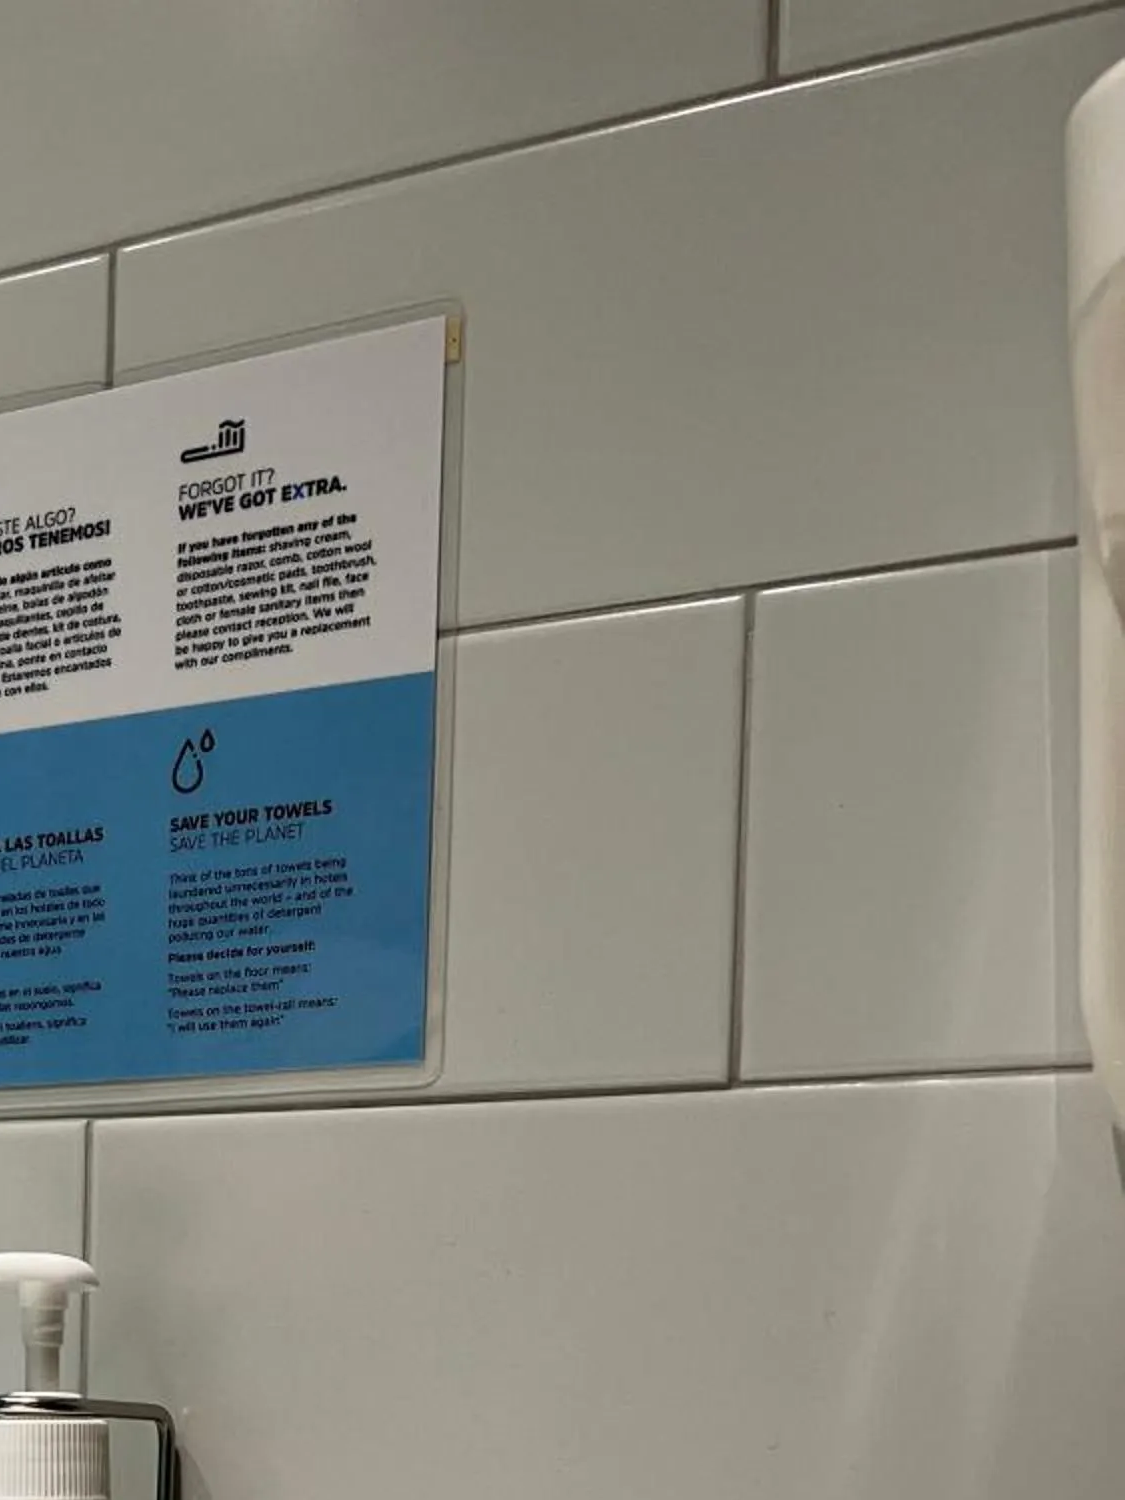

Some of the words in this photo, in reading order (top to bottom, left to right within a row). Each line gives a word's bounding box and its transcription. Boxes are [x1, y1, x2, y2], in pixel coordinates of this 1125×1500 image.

[179, 474, 246, 501] FORGOT
[251, 468, 275, 487] IT?
[179, 496, 235, 521] WE'VE
[239, 487, 277, 509] GOT
[281, 476, 347, 502] EXTRA.
[25, 507, 75, 531] ALGO?
[29, 519, 110, 549] TENEMOS!
[178, 542, 187, 554] If
[189, 541, 209, 553] you
[212, 535, 239, 548] have
[241, 525, 294, 542] forgotten
[297, 521, 319, 532] any
[321, 516, 334, 528] of
[337, 514, 357, 525] the
[177, 552, 229, 568] following
[269, 537, 311, 552] shaving
[306, 547, 341, 560] cotton
[345, 540, 372, 553] wool
[177, 588, 188, 597] or
[239, 587, 277, 602] sewing
[299, 578, 319, 591] nail
[345, 572, 369, 584] face
[175, 628, 209, 642] please
[212, 620, 252, 635] contact
[313, 608, 331, 619] We
[335, 603, 354, 616] will
[176, 614, 202, 627] cloth
[205, 612, 216, 622] or
[219, 605, 256, 619] female
[259, 598, 301, 613] sanitary
[305, 592, 335, 605] items
[339, 588, 365, 600] then
[175, 646, 189, 656] be
[192, 640, 225, 652] happy
[228, 638, 239, 647] to
[242, 634, 264, 646] give
[267, 630, 287, 642] you
[291, 628, 297, 638] a
[300, 616, 370, 636] replacement
[175, 658, 197, 670] with
[201, 656, 219, 666] our
[170, 813, 209, 832] SAVE
[213, 808, 259, 828] YOUR
[264, 800, 332, 823] TOWELS
[5, 835, 33, 853] LAS
[35, 827, 104, 850] TOALLAS
[171, 833, 205, 852] SAVE
[210, 829, 239, 847] THE
[245, 822, 305, 843] PLANET
[0, 856, 18, 872] EL
[21, 848, 83, 869] PLANETA
